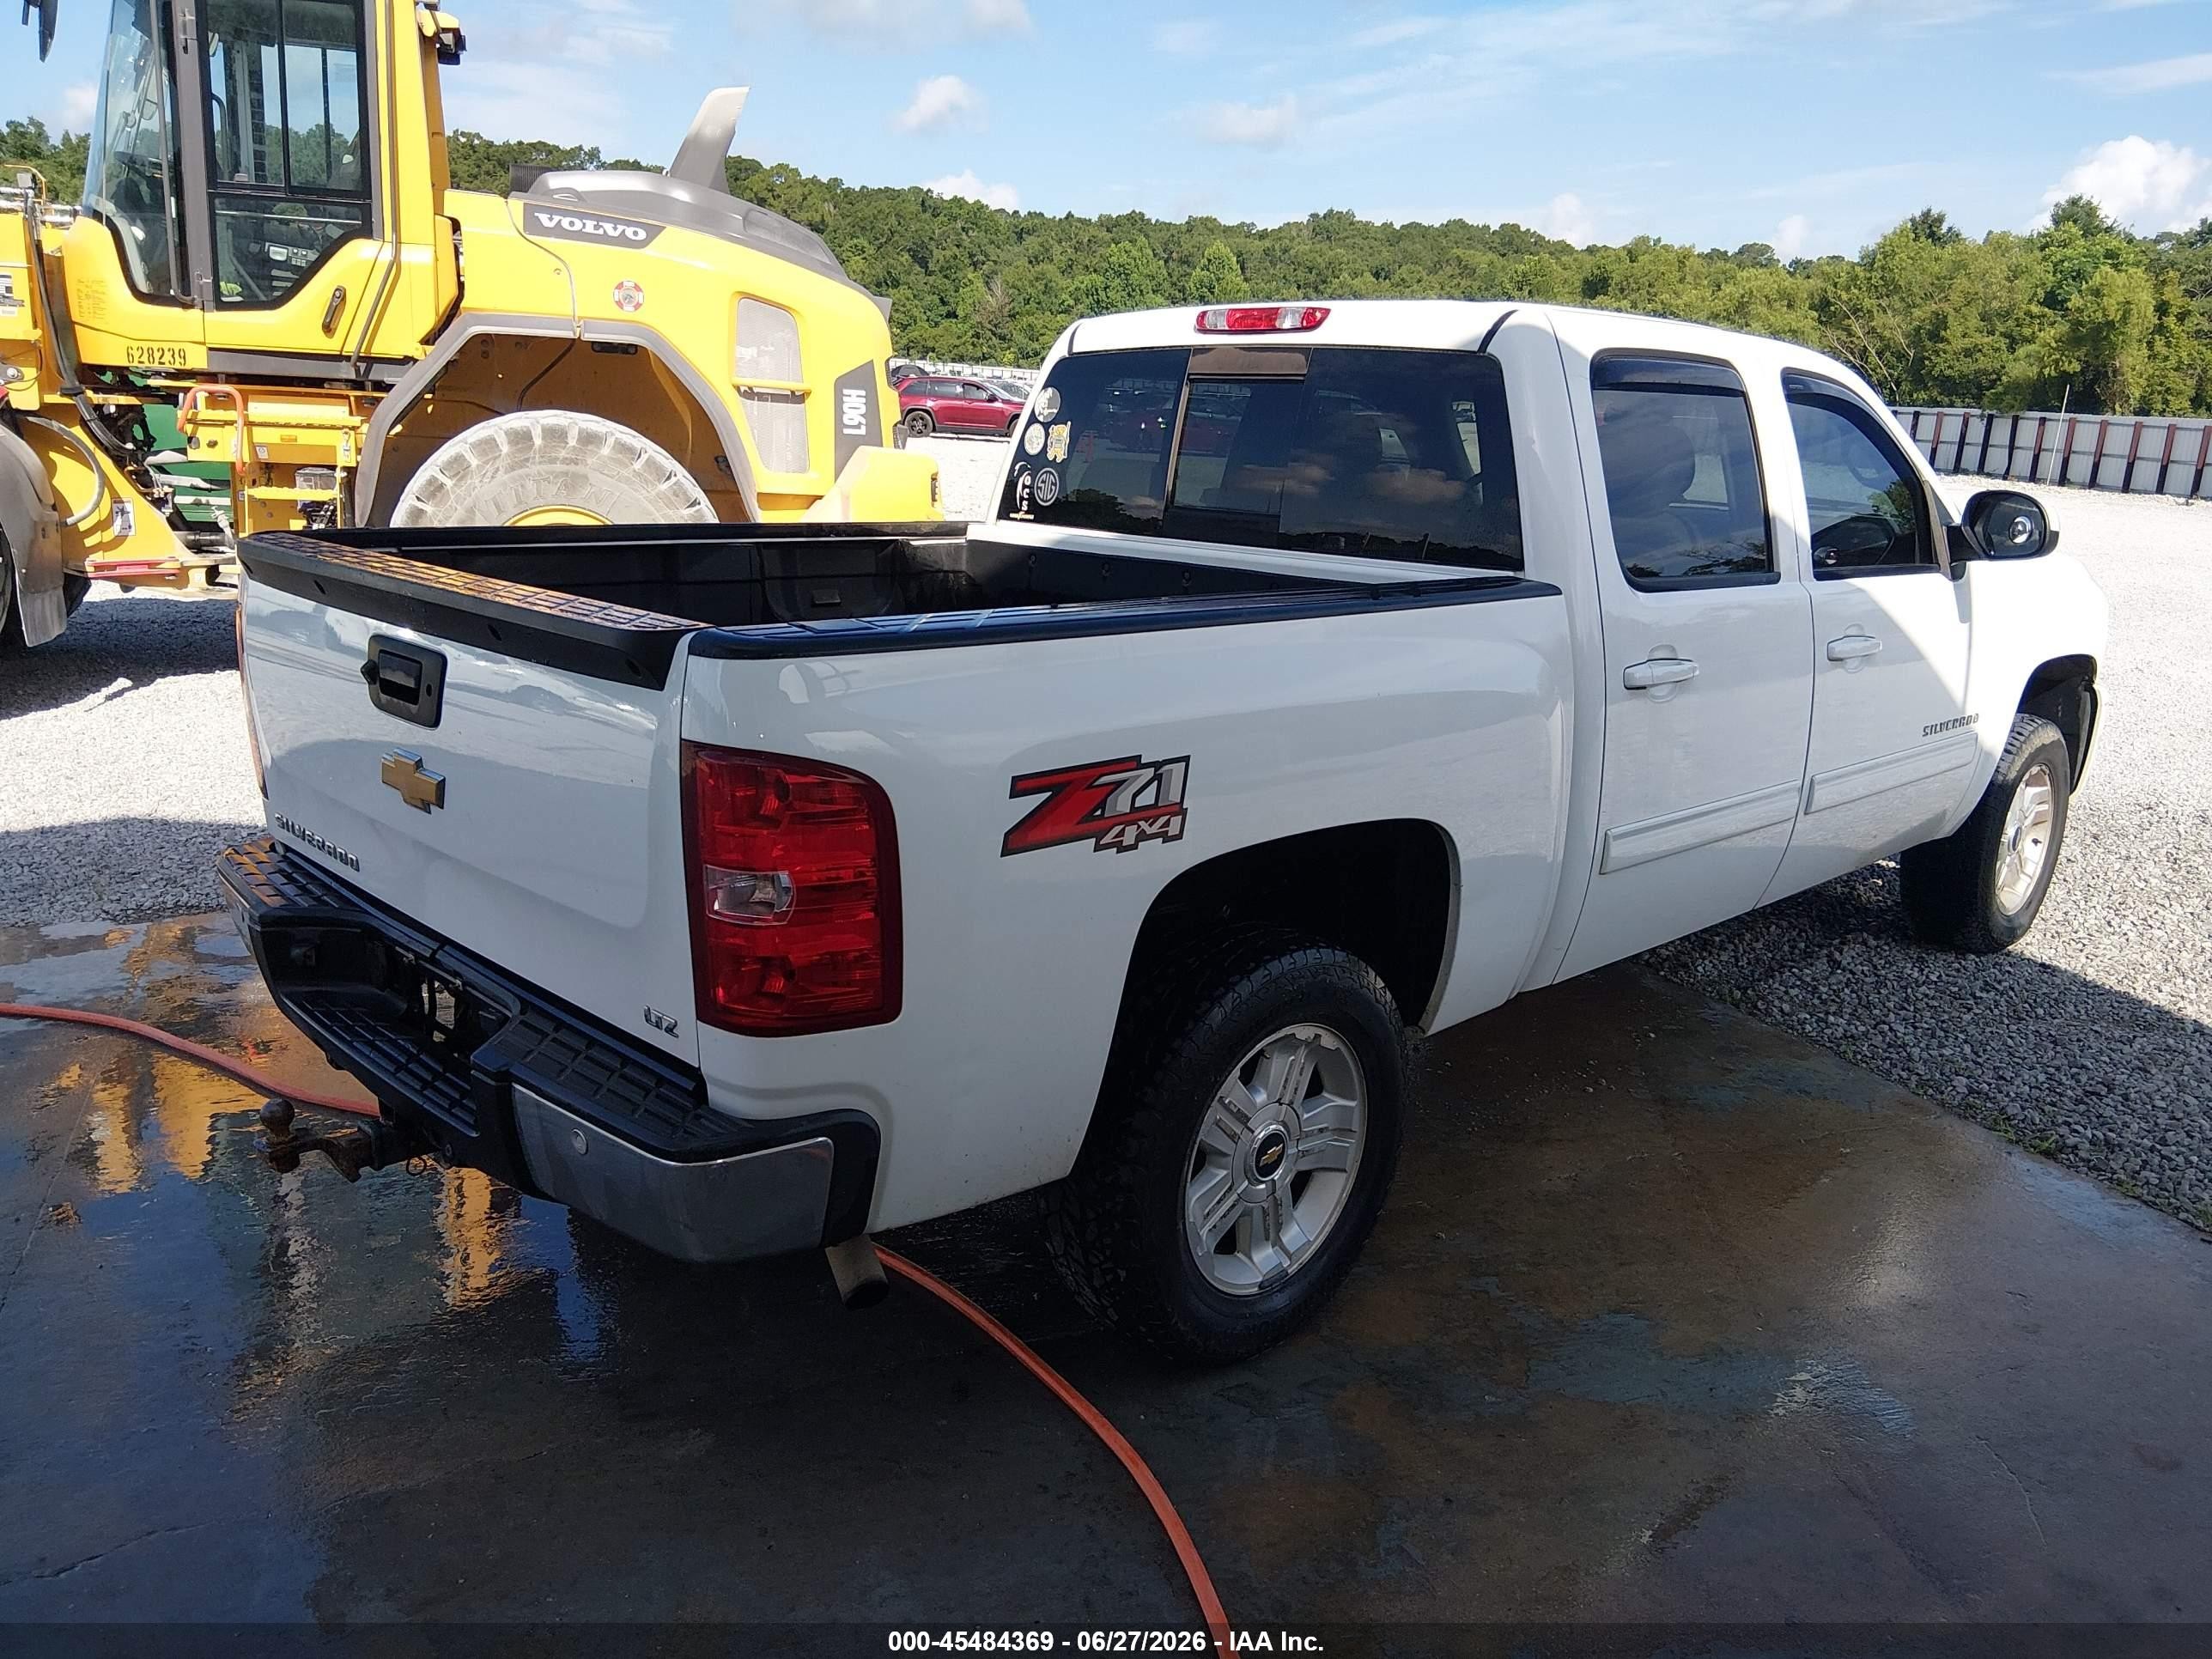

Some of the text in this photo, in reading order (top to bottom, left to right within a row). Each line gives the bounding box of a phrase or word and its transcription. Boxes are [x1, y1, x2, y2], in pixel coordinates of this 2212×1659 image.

[534, 213, 647, 240] VOLVO
[126, 345, 186, 367] 628239
[842, 389, 866, 435] L90H
[1037, 472, 1056, 501] SIG
[1922, 713, 1979, 737] SILVERADO
[1000, 755, 1191, 858] Z71
[275, 811, 360, 872] SILVERADO
[643, 1006, 679, 1038] LTZ
